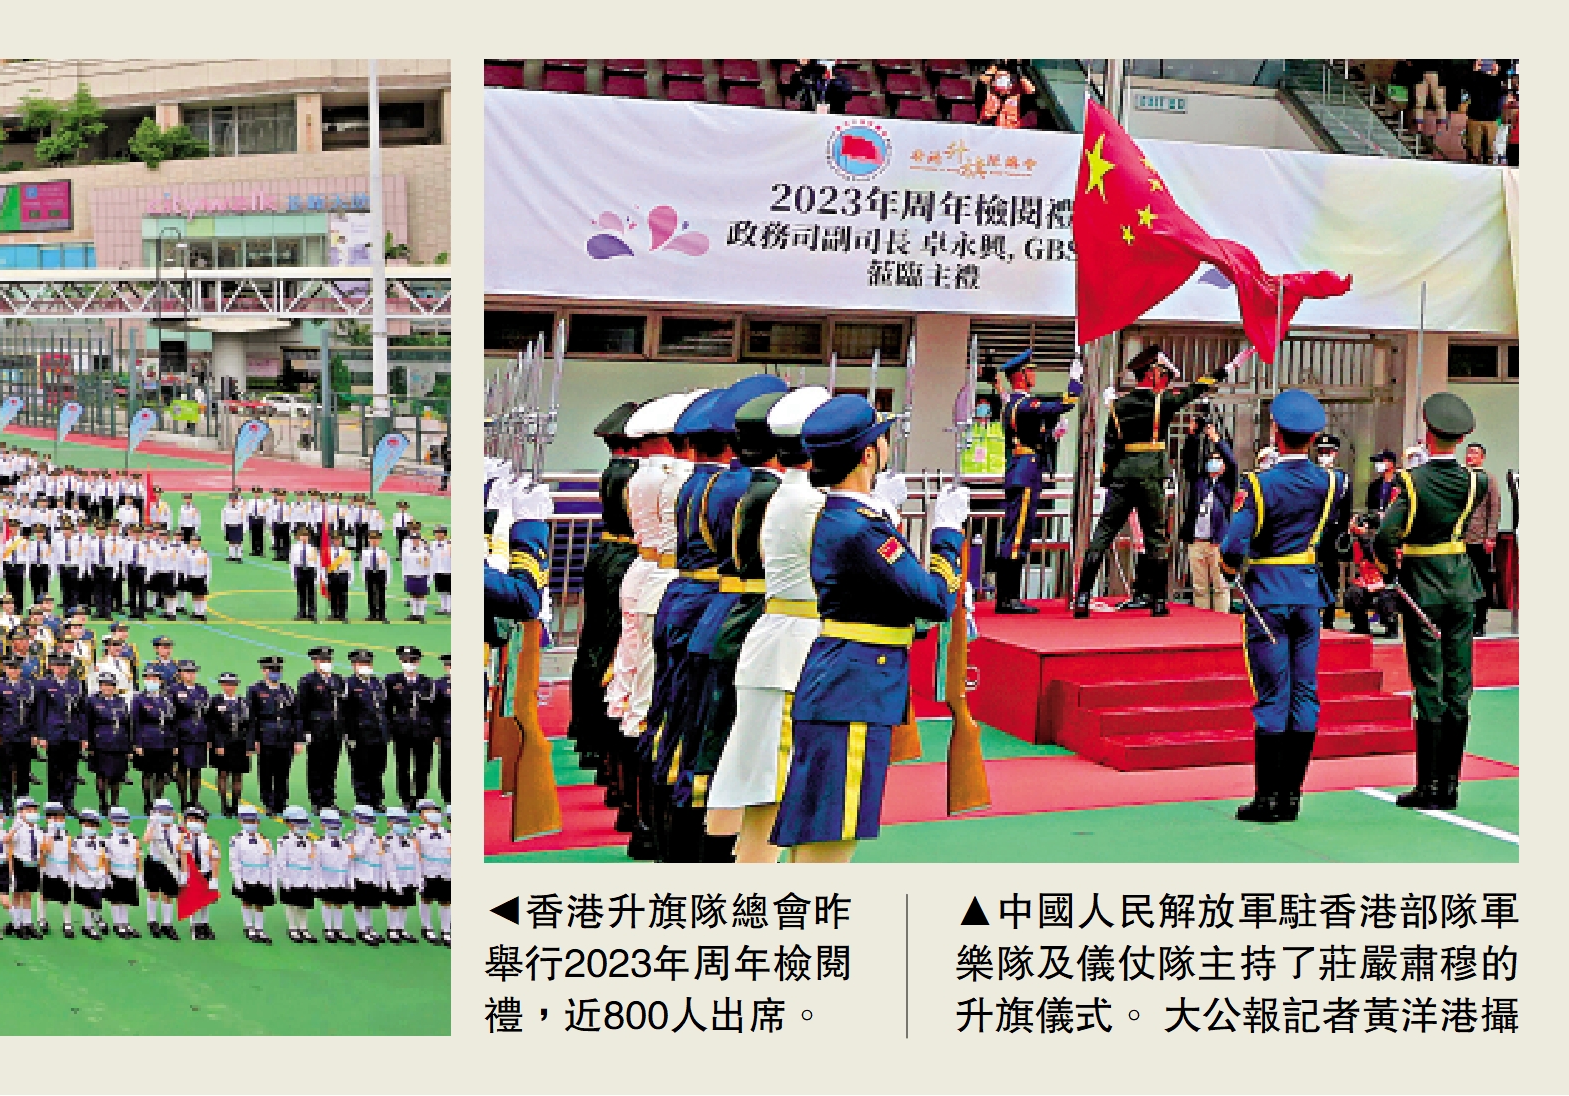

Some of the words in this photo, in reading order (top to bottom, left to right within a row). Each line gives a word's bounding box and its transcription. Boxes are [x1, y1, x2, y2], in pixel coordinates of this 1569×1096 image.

[726, 219, 911, 256] 政務司副司長
